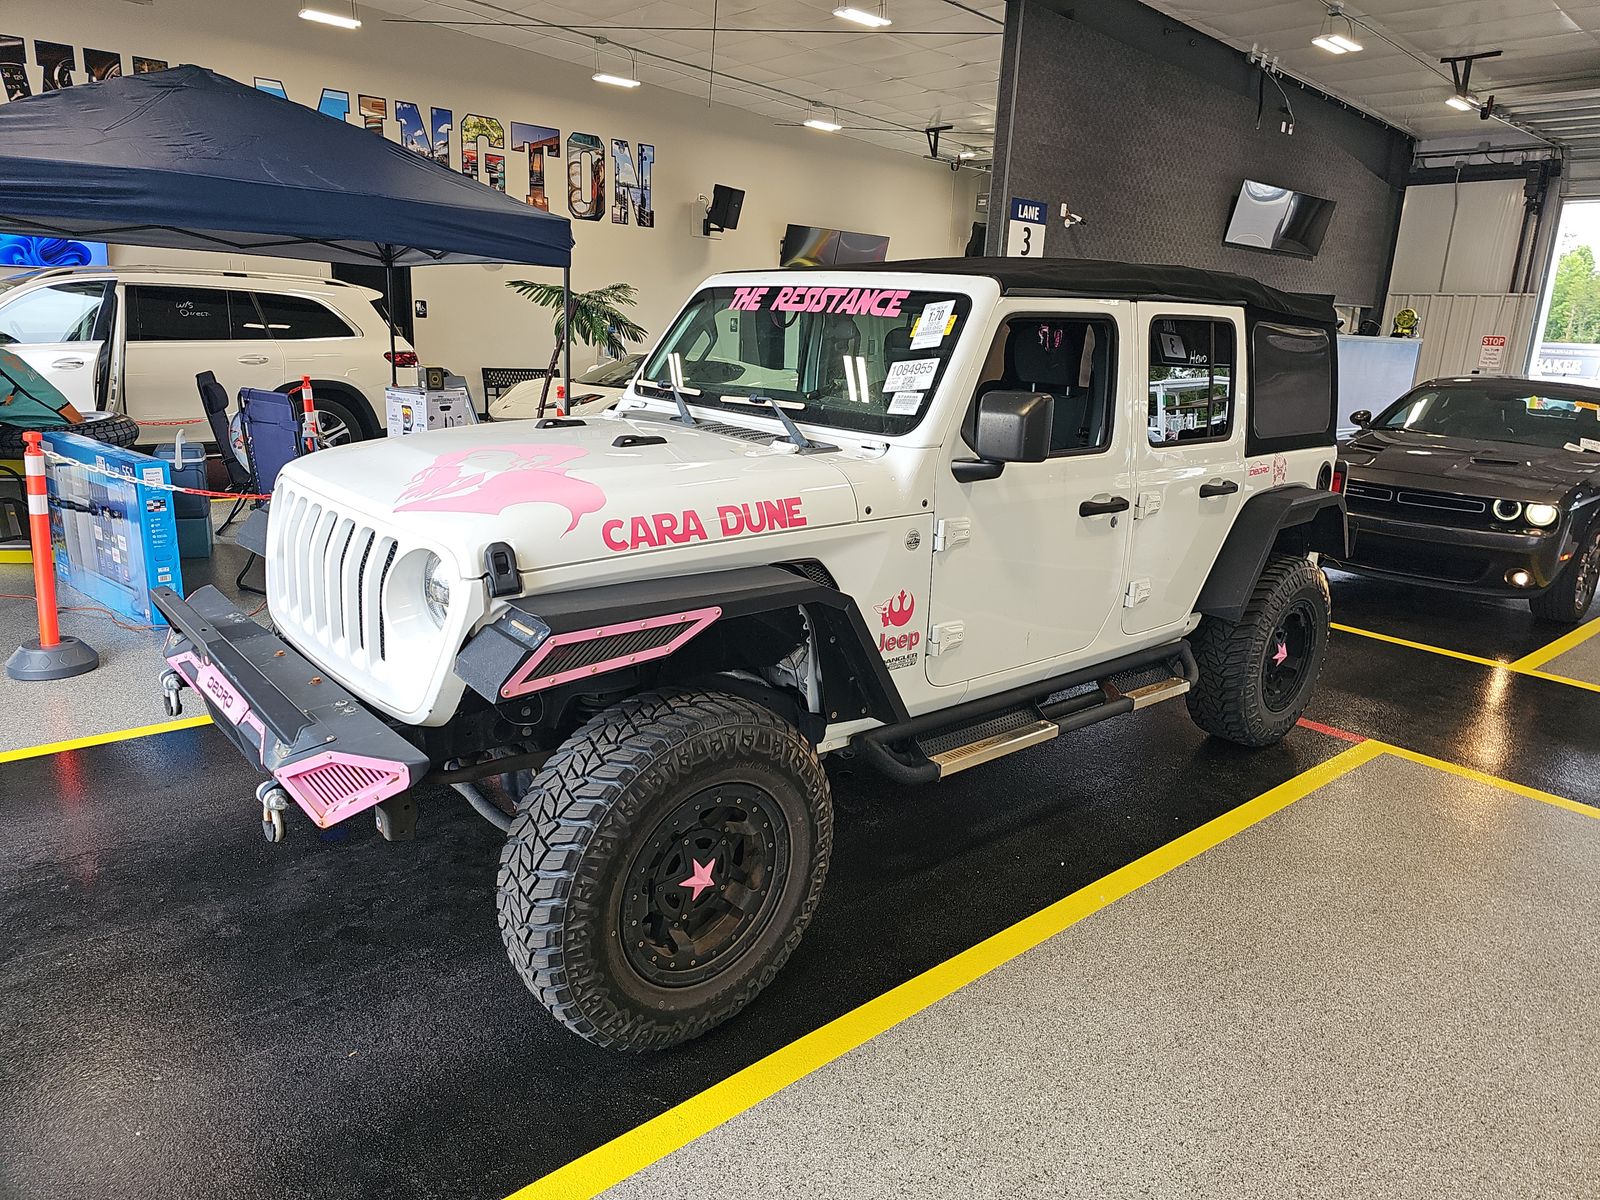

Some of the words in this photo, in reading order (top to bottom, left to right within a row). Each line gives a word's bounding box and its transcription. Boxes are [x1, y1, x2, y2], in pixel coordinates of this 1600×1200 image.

[1018, 204, 1040, 220] LANE
[1020, 226, 1032, 256] 3
[728, 287, 770, 311] THE
[770, 287, 911, 318] RESISTANCE
[1482, 337, 1505, 346] STOP
[891, 362, 934, 376] 1084955
[602, 510, 708, 552] CARA
[716, 496, 808, 538] DUNE
[880, 631, 920, 652] Jeep
